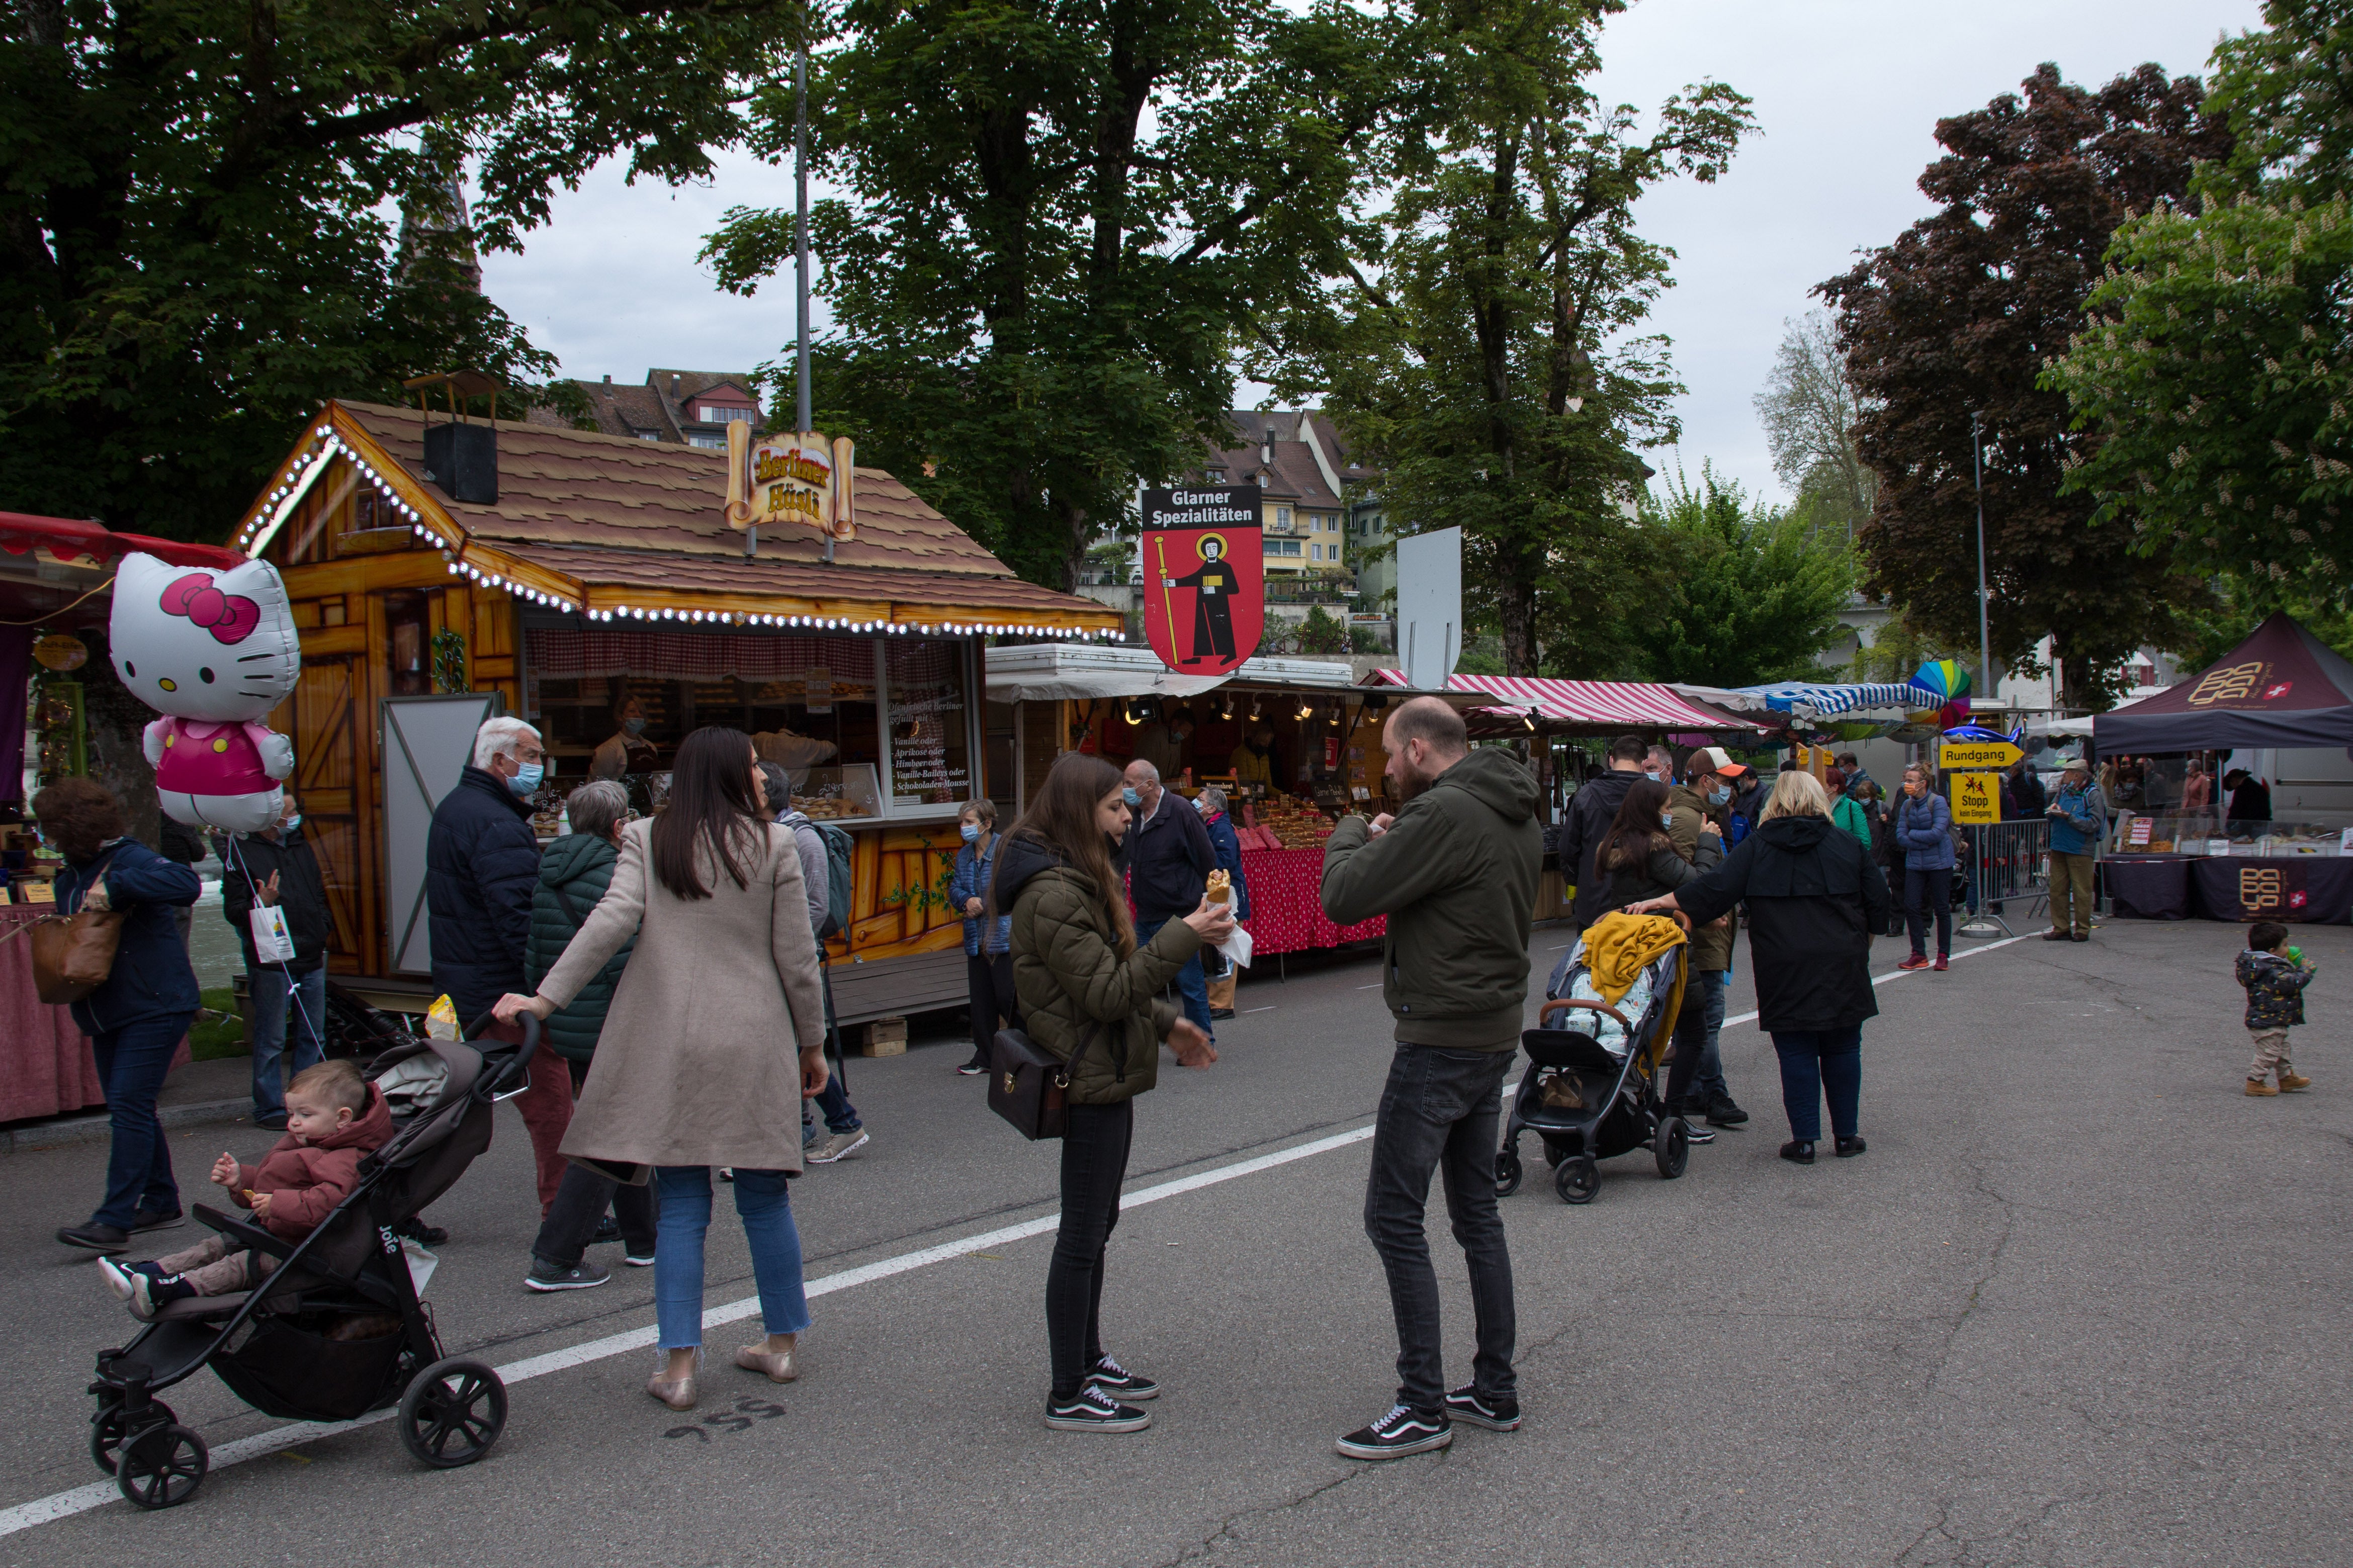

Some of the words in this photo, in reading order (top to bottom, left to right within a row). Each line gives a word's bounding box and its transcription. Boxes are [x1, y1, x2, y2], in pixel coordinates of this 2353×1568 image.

[759, 448, 831, 487] Berliner
[768, 483, 820, 520] Hüsli
[1172, 490, 1231, 506] Glarner
[1152, 507, 1252, 528] Spezialitäten
[888, 701, 932, 713] Ofenfrische
[933, 702, 964, 710] Berliner
[889, 714, 914, 725] gefüllt
[916, 714, 928, 722] mit
[894, 737, 919, 746] Vanille
[920, 736, 938, 745] oder
[895, 748, 928, 759] Aprikose
[1946, 750, 2005, 762] Rundgang
[895, 759, 927, 768] Himbeer
[896, 769, 948, 779] Vanille-Baileys
[949, 767, 966, 776] oder
[533, 780, 562, 801] anille-
[897, 779, 970, 791] Schokoladen-Mousse
[1962, 795, 1988, 808] Stopp
[1971, 809, 1992, 818] Eingang
